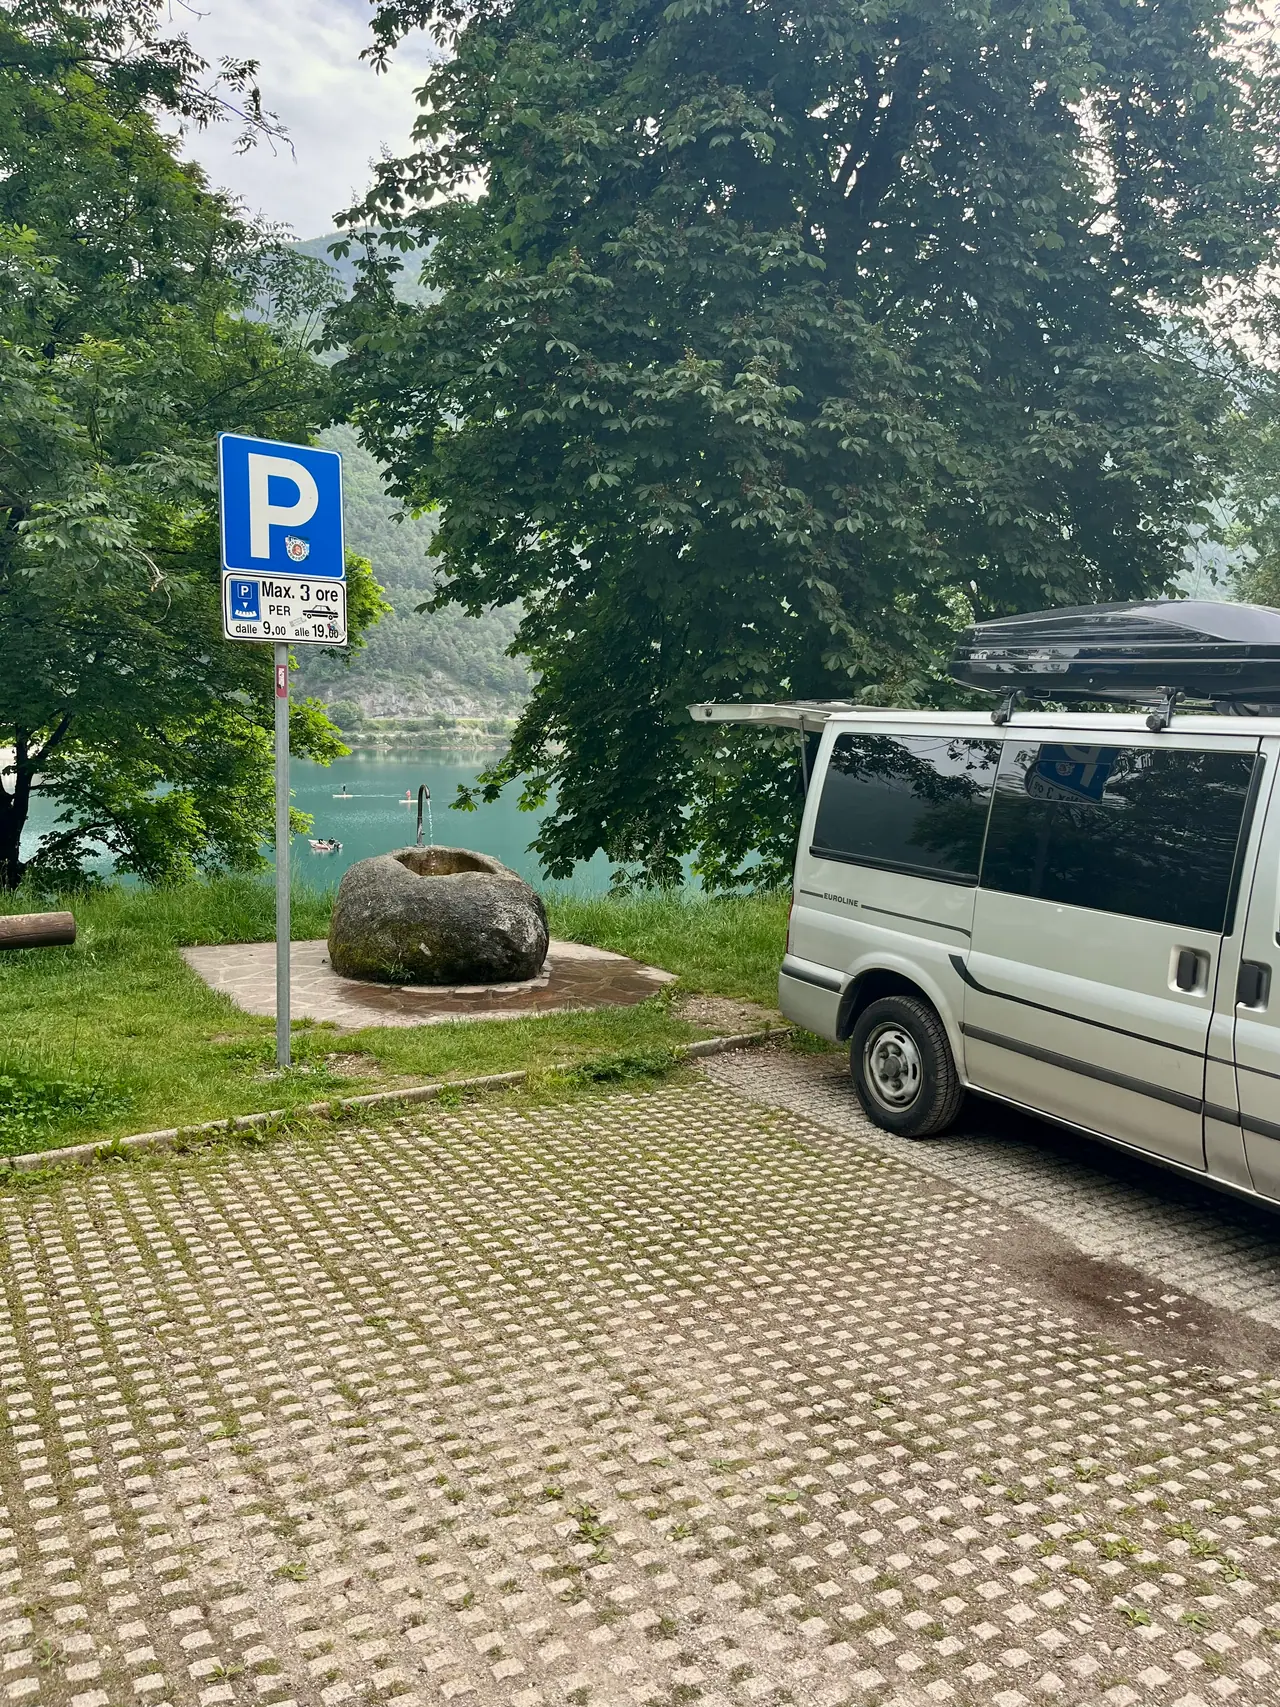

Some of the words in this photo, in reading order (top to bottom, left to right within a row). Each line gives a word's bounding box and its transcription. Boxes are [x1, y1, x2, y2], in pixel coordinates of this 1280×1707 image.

[248, 453, 319, 559] P
[241, 585, 249, 596] P
[262, 581, 295, 599] Max.
[300, 584, 310, 601] 3
[316, 588, 338, 602] ore
[269, 604, 291, 616] PER
[235, 624, 257, 634] dalle
[263, 621, 286, 636] 9,00
[294, 627, 310, 637] alle
[823, 892, 859, 907] EUROLINE
